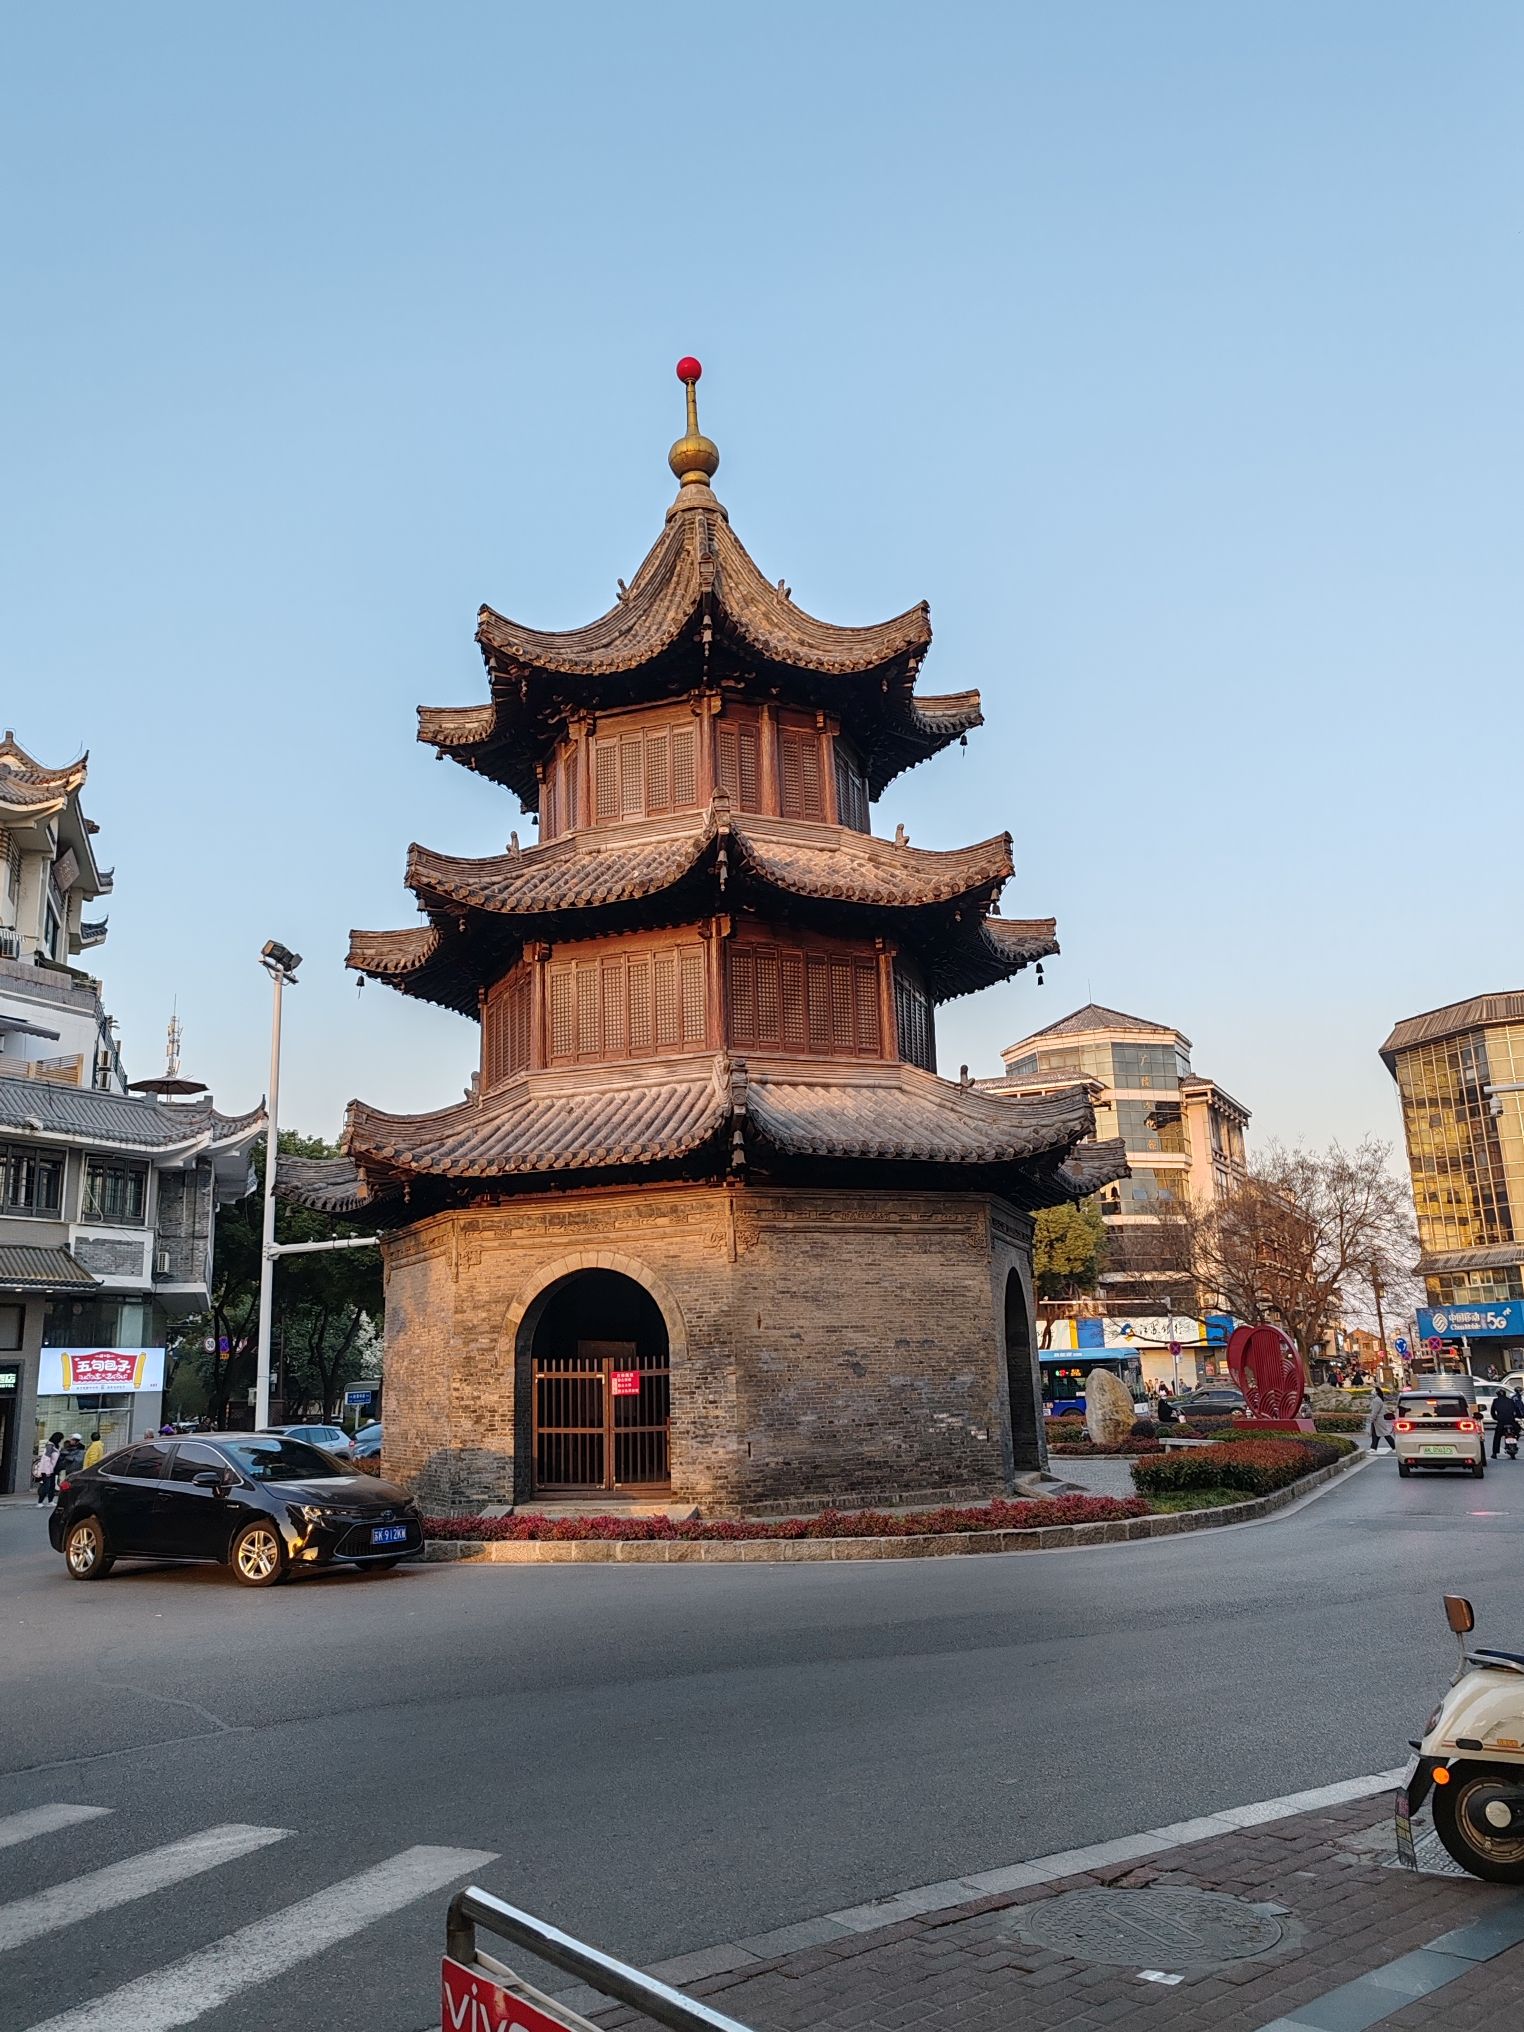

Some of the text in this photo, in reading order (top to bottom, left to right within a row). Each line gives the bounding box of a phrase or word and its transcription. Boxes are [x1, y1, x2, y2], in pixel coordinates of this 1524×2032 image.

[1449, 1311, 1480, 1323] 中国移动
[1487, 1311, 1507, 1330] 5G
[76, 1360, 131, 1373] 五句包子
[444, 1981, 531, 2032] viv
